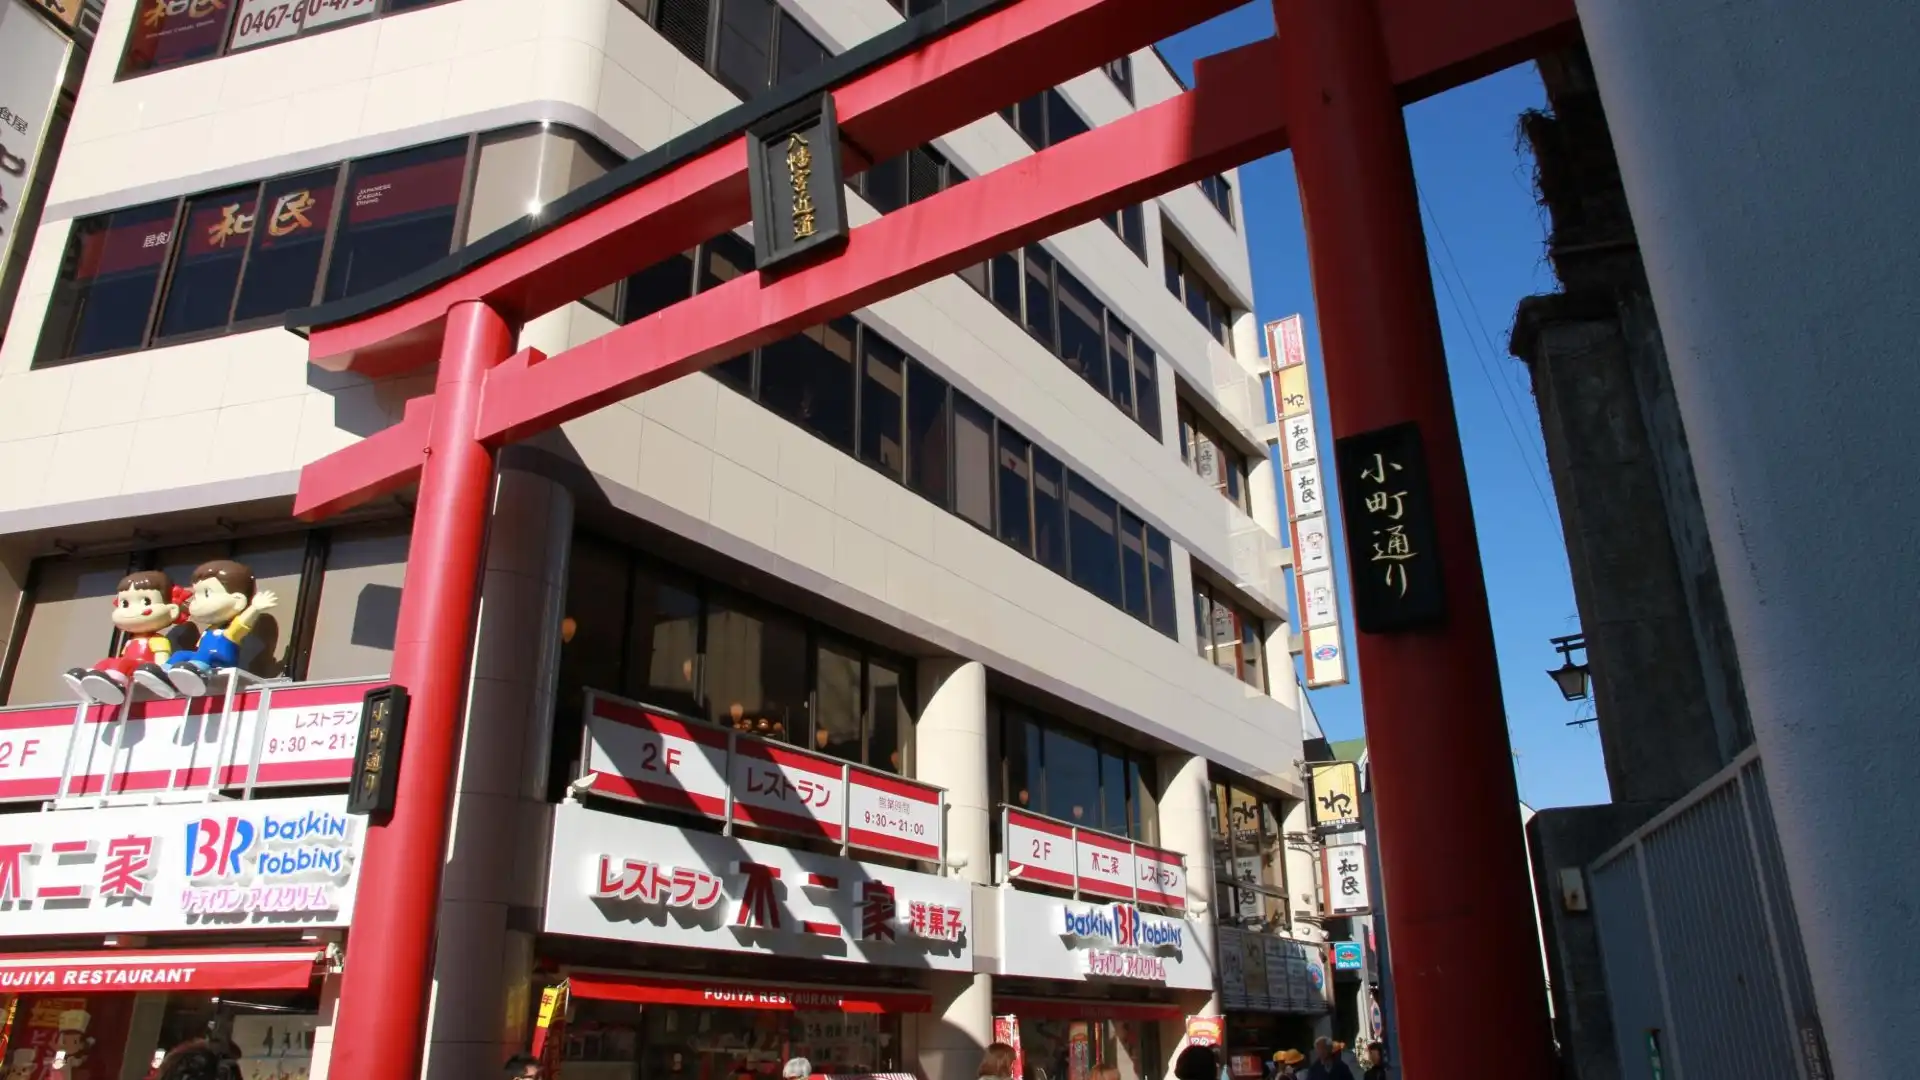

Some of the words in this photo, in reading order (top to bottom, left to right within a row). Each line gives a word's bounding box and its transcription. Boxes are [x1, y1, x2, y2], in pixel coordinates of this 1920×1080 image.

[1361, 454, 1419, 598] 小町通り
[295, 710, 358, 729] レストラン
[364, 702, 389, 792] 小町通り
[641, 743, 682, 775] 2F
[746, 767, 832, 807] レストラン
[878, 796, 911, 815] 営業時間
[1318, 789, 1353, 818] わん
[263, 810, 347, 841] baskin
[257, 846, 342, 876] robbins
[1032, 839, 1051, 860] 2F
[1091, 852, 1121, 876] 不二家
[1140, 863, 1178, 888] レストラン
[1337, 858, 1360, 895] 和民
[181, 887, 242, 911] サーティワン
[246, 885, 329, 911] アイスクリーム
[599, 855, 722, 908] レストラン
[737, 861, 896, 942] 不二家
[908, 903, 963, 940] 洋菓子
[1064, 905, 1113, 940] baskin
[1141, 921, 1183, 947] robbins
[0, 972, 55, 986] UJIYA
[63, 968, 196, 985] RESTAURANT
[704, 988, 755, 1003] FUJIYA
